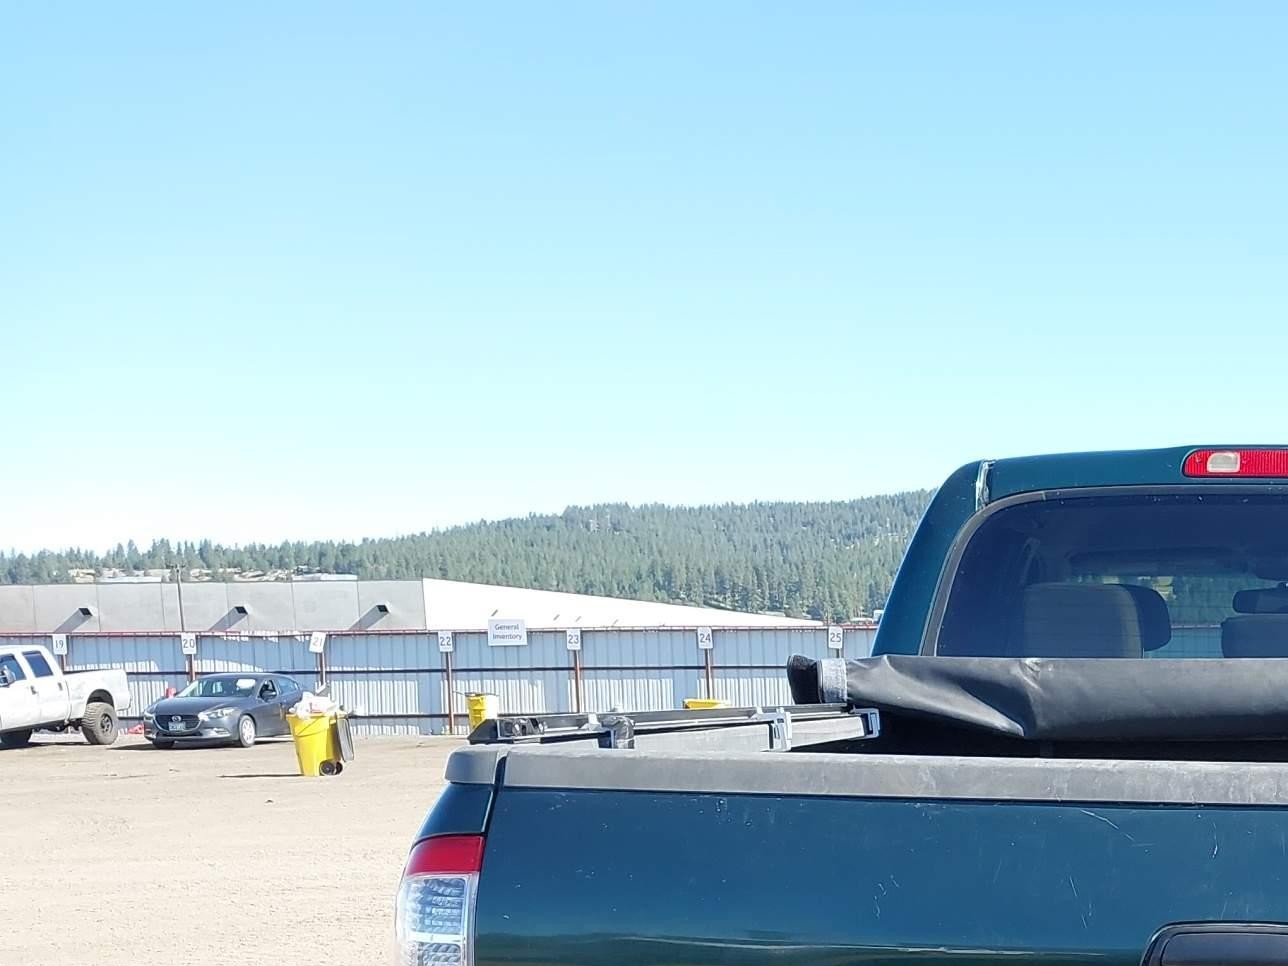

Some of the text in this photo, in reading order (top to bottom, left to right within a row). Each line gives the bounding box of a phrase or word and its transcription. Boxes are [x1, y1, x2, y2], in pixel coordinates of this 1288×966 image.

[494, 623, 520, 631] General
[312, 636, 323, 647] 21
[439, 636, 452, 647] 22
[492, 633, 522, 641] Inventory
[567, 634, 579, 645] 23
[699, 633, 711, 643] 24
[830, 632, 842, 643] 25
[55, 639, 64, 649] 19
[182, 638, 195, 649] 20
